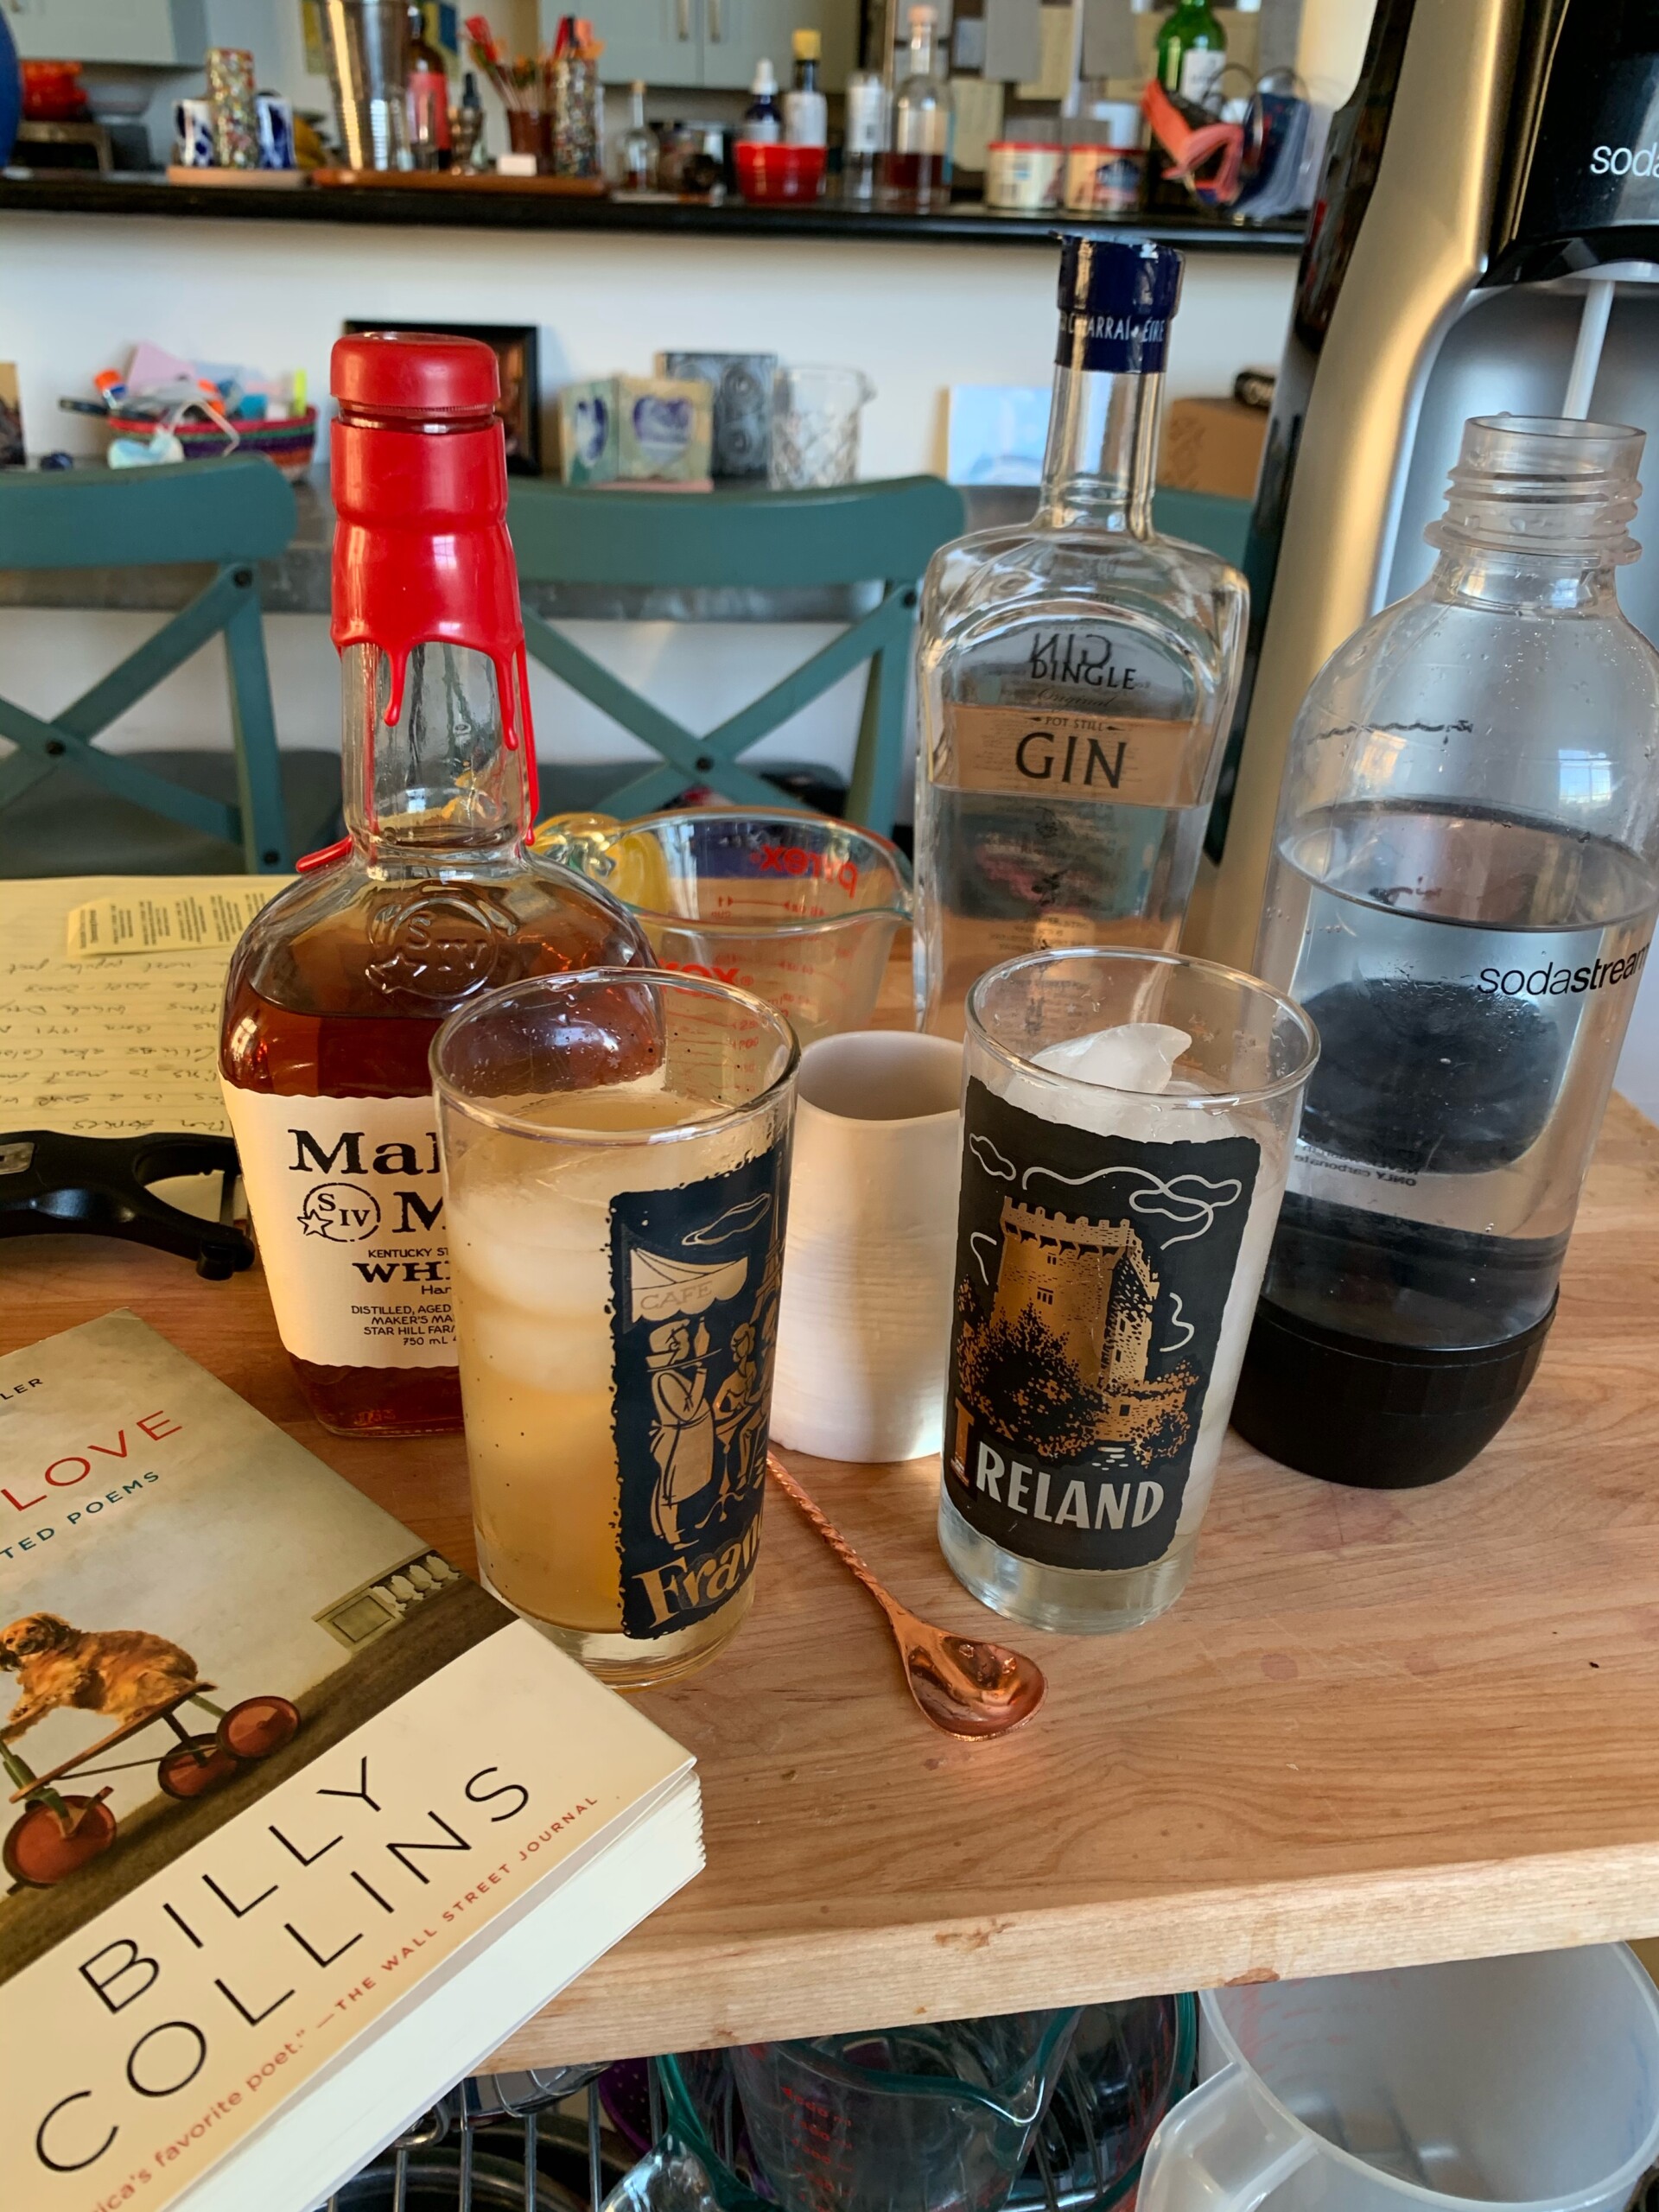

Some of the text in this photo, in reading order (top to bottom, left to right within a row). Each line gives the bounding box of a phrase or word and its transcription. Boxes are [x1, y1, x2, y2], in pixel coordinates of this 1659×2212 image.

[1032, 659, 1137, 690] DINGLE
[1045, 716, 1104, 732] POT STILL
[1015, 731, 1127, 789] GIN
[368, 1248, 432, 1258] KENTUCKY
[351, 1304, 452, 1316] DISTILLED, AGED
[641, 1280, 713, 1310] CAFE
[364, 1326, 395, 1335] STAR
[397, 1325, 425, 1335] HILL
[372, 1315, 429, 1325] MAKER'S
[403, 1337, 424, 1346] 750
[1, 1410, 183, 1511] LOVE
[67, 1471, 159, 1525] POEMS
[79, 1756, 382, 2015] BILLY
[36, 1766, 530, 2173] COLLINS
[154, 2091, 243, 2168] favorite
[380, 1928, 438, 1973] WALL
[442, 1863, 512, 1923] STREET
[518, 1796, 599, 1862] JOURNAL
